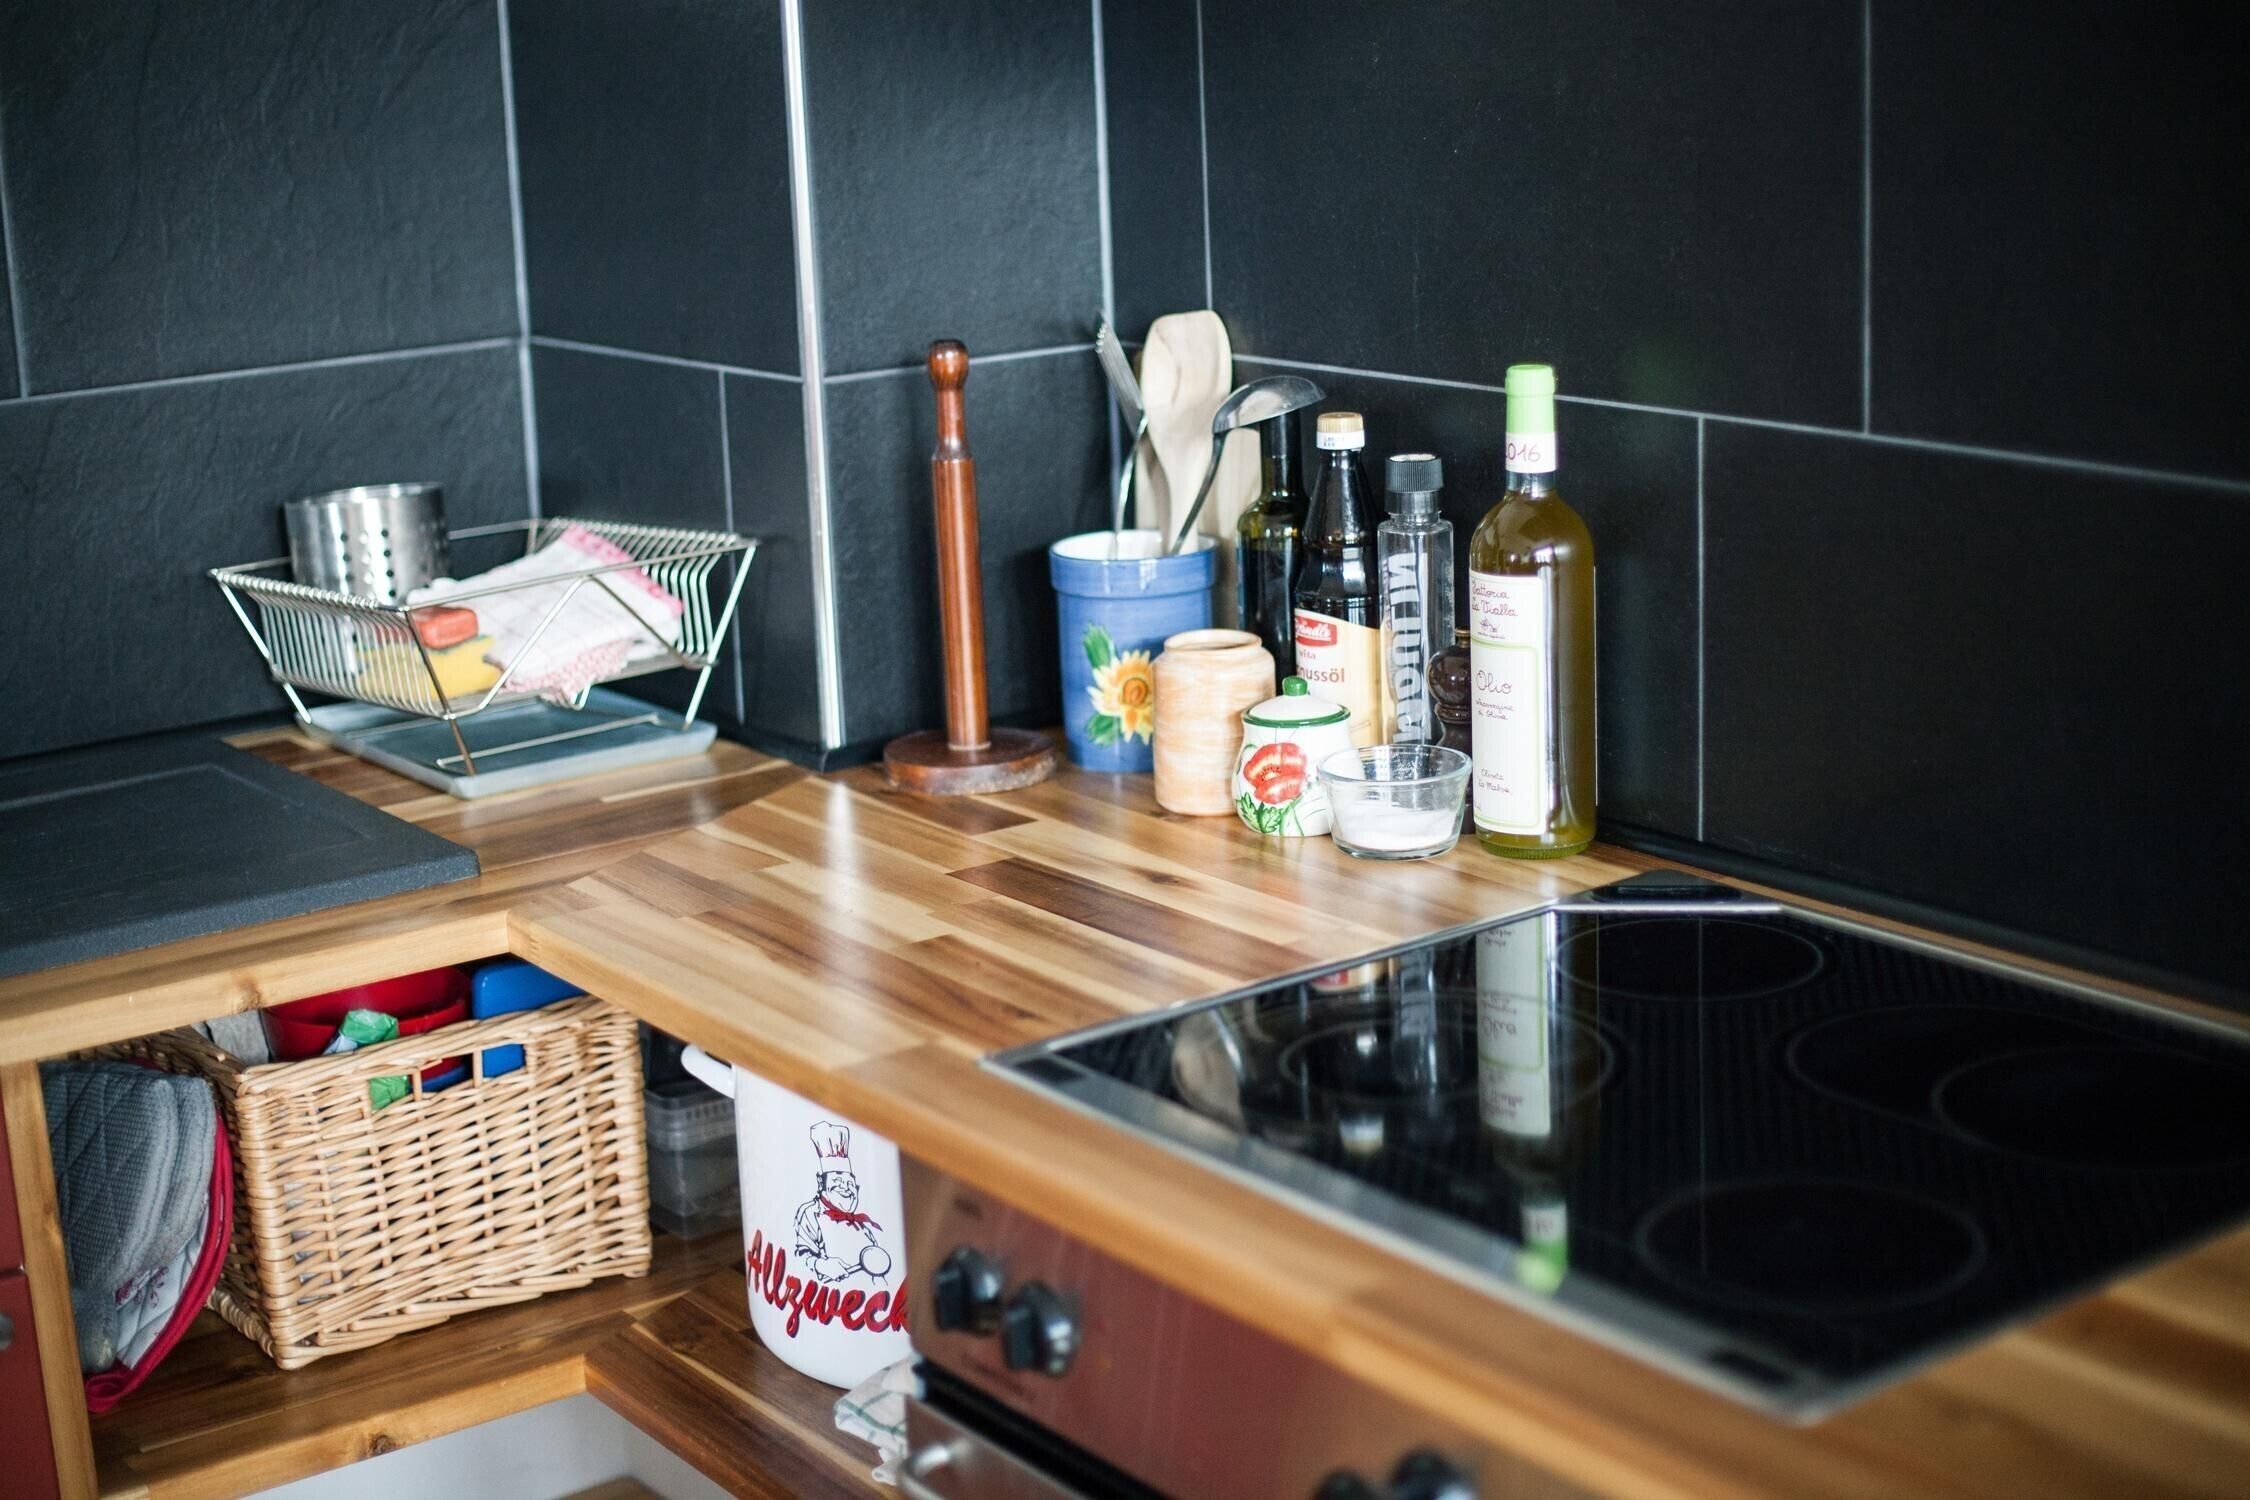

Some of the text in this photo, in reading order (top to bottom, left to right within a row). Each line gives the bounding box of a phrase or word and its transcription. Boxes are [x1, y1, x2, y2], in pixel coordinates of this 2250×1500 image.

[1506, 442, 1541, 462] 016
[1297, 664, 1345, 683] nussöl
[1476, 670, 1512, 694] Olio
